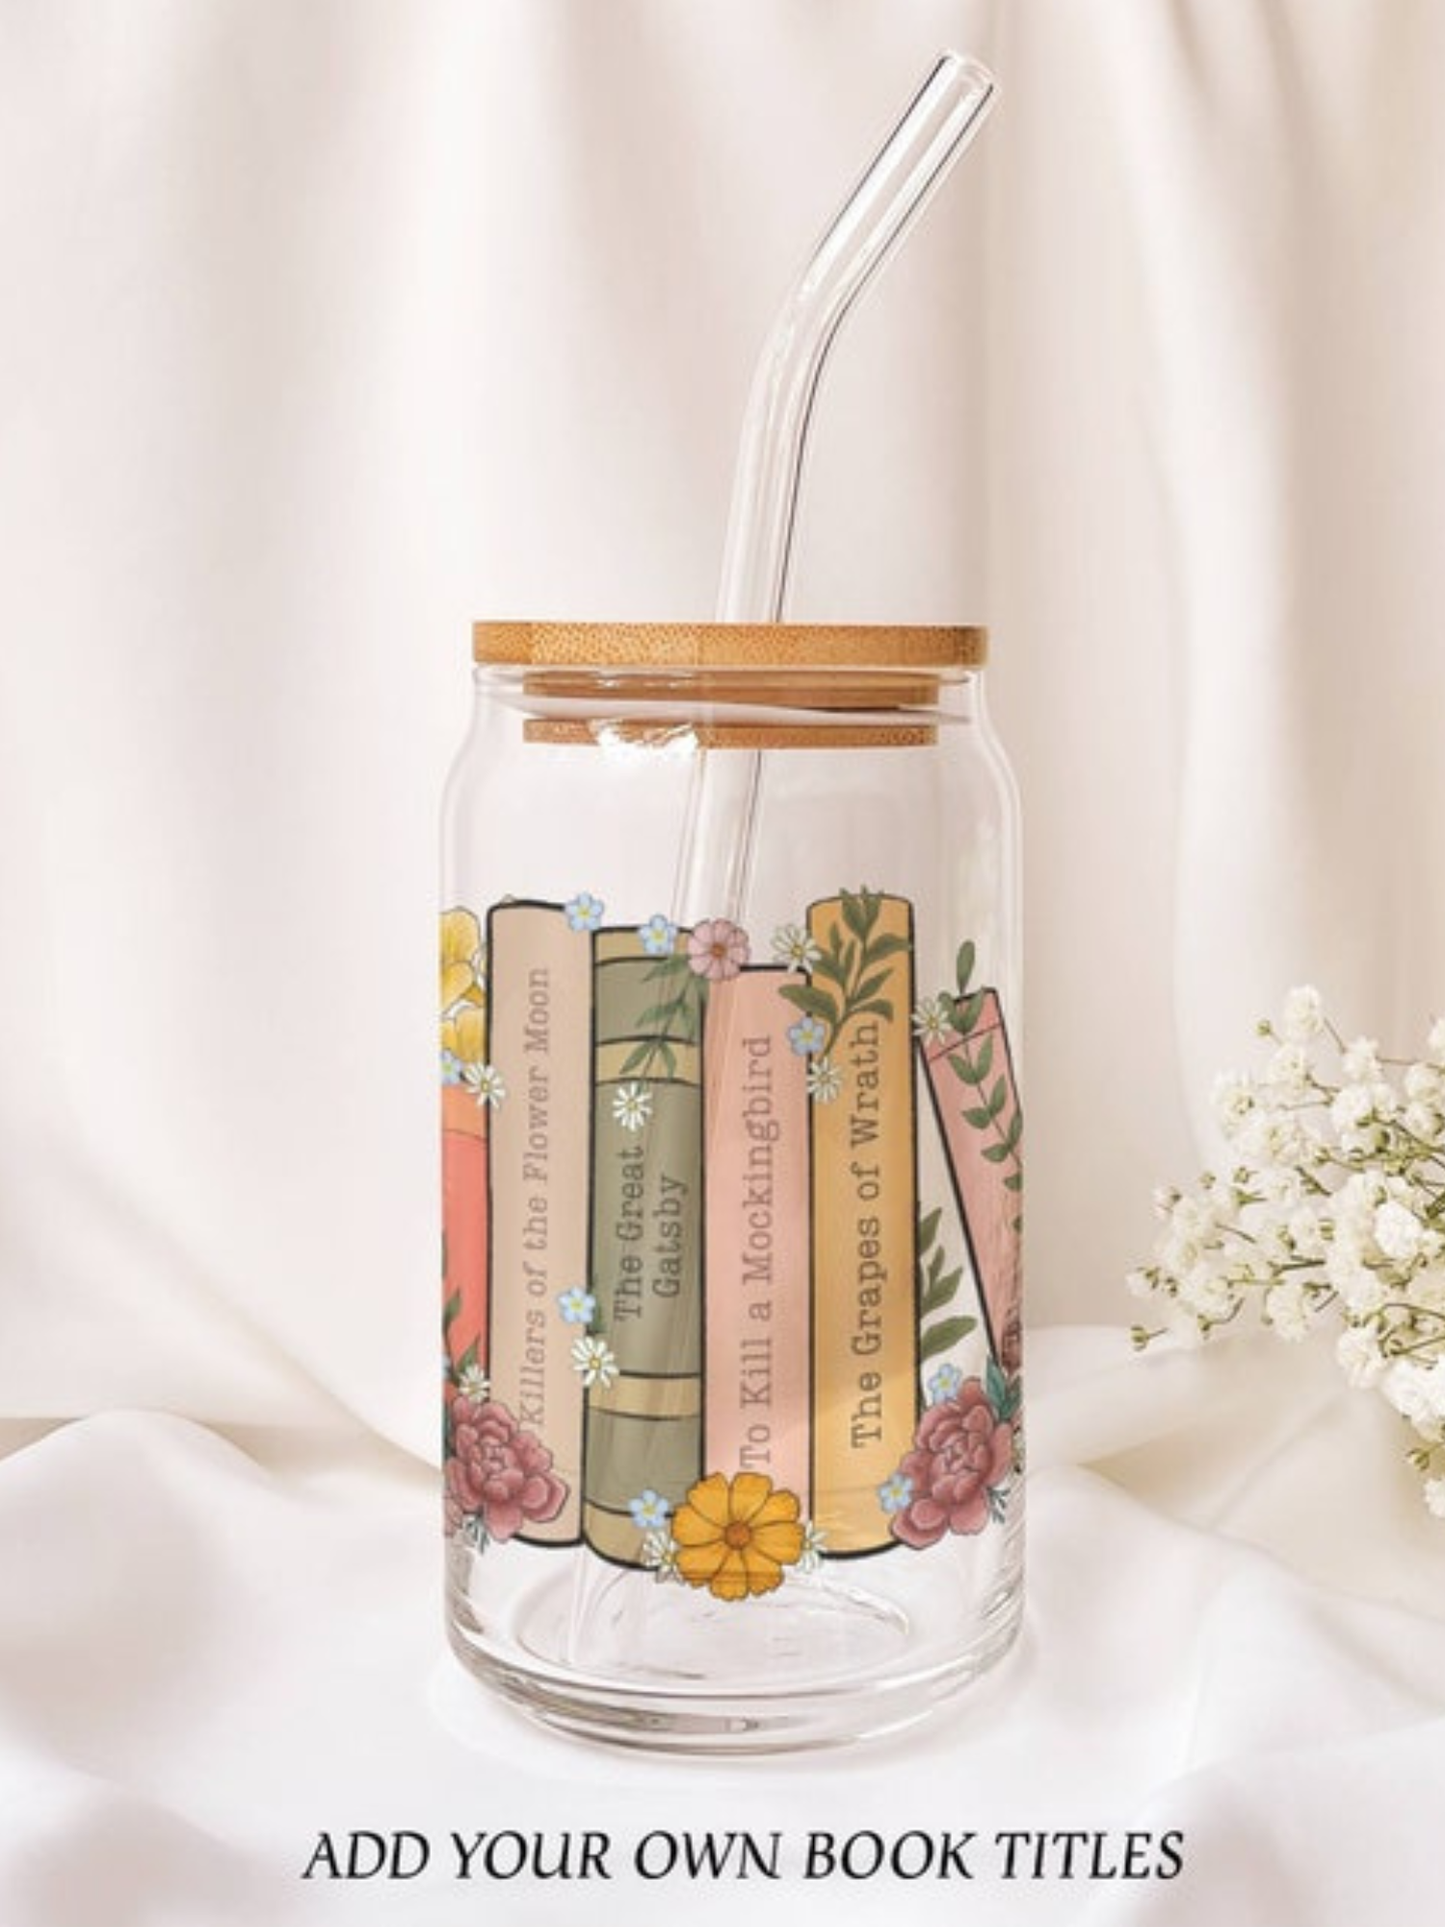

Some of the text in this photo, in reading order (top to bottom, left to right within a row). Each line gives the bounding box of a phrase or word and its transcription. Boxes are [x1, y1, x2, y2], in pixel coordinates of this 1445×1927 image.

[519, 967, 550, 1428] Killers of the Flower Moon
[613, 1146, 643, 1321] The Great
[652, 1172, 689, 1298] Gatsby
[740, 1035, 780, 1469] To Kill a Mockingbird
[850, 1021, 887, 1449] The Grapes of Wrath
